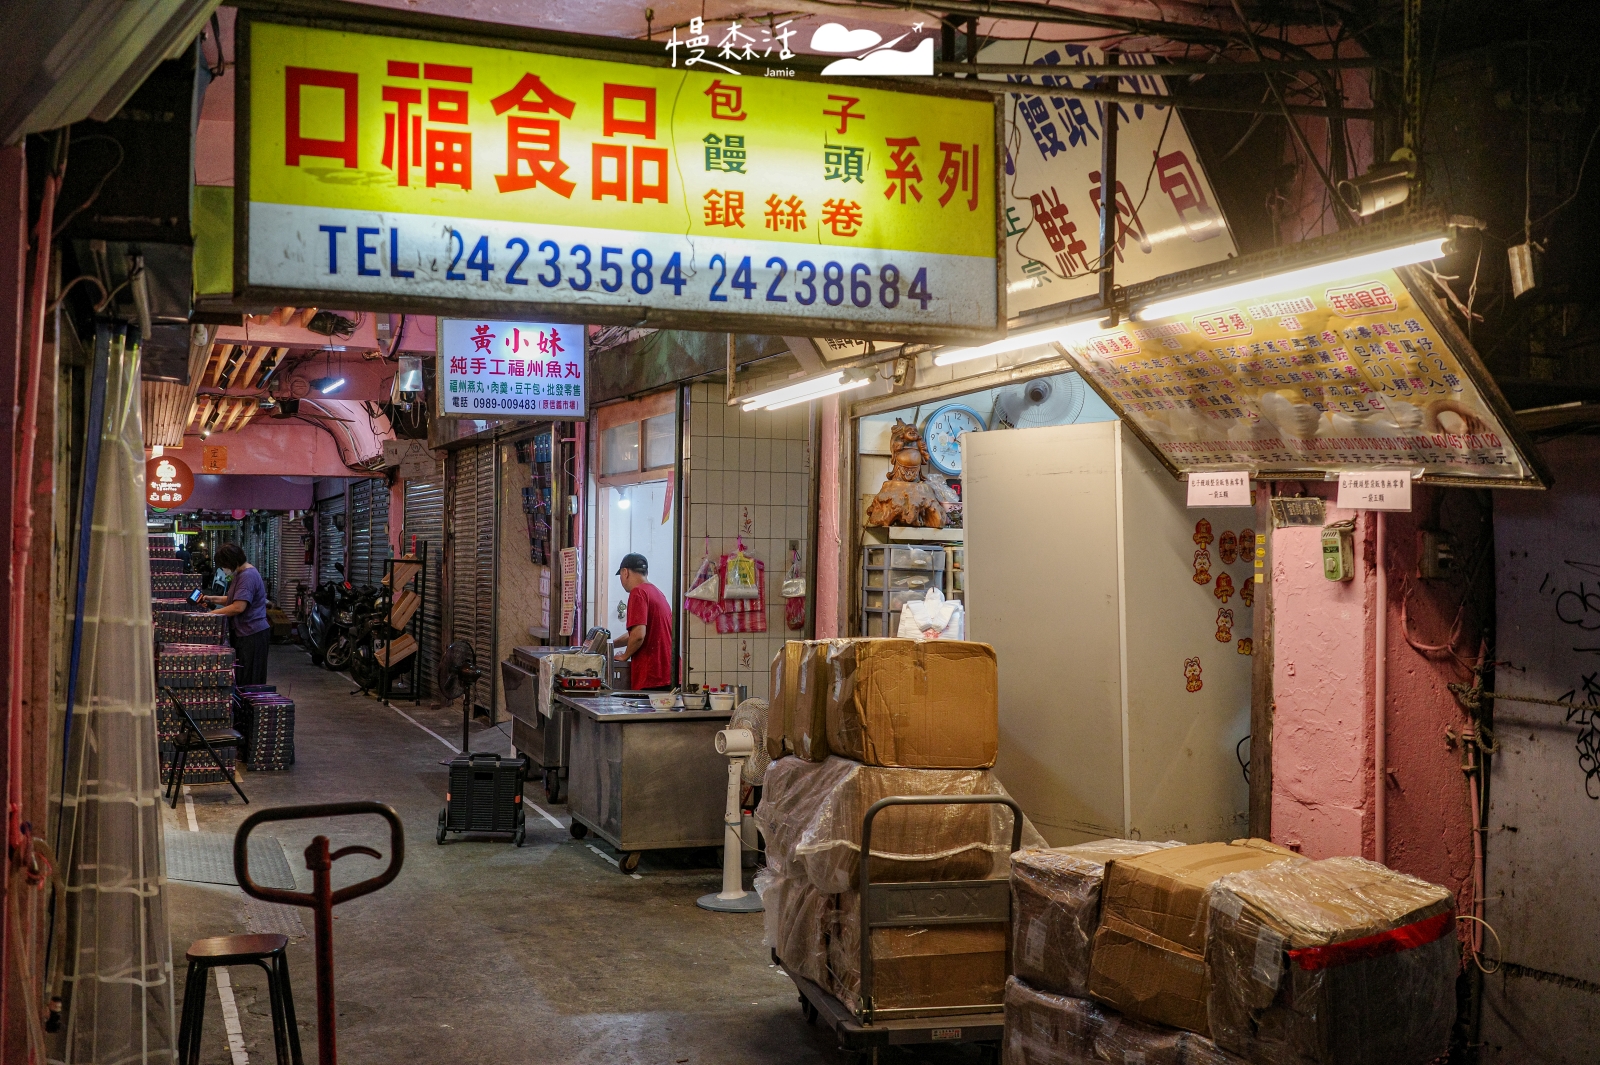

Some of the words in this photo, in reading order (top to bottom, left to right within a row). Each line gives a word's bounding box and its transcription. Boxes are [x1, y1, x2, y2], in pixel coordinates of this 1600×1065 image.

[285, 60, 668, 204] 口福食品
[884, 136, 980, 212] 系列
[703, 189, 864, 237] 銀絲卷
[319, 225, 414, 279] TEL
[446, 230, 687, 296] 24233584
[709, 253, 932, 310] 24238684
[1330, 287, 1392, 312] 年節食品
[1199, 313, 1248, 336] 包子類
[470, 325, 565, 357] 黃小妹
[450, 356, 581, 379] 純手工福州魚丸
[1215, 349, 1251, 387] 豆沙包
[1226, 347, 1263, 386] 芝麻包
[1237, 345, 1276, 385] 奶酥包
[1250, 344, 1288, 384] 芋泥包
[452, 397, 468, 408] 電話
[473, 398, 536, 410] 0989-009483
[954, 412, 962, 421] 12
[935, 422, 943, 430] 10
[932, 445, 938, 453] 8
[940, 454, 946, 462] 7
[950, 460, 956, 468] 6
